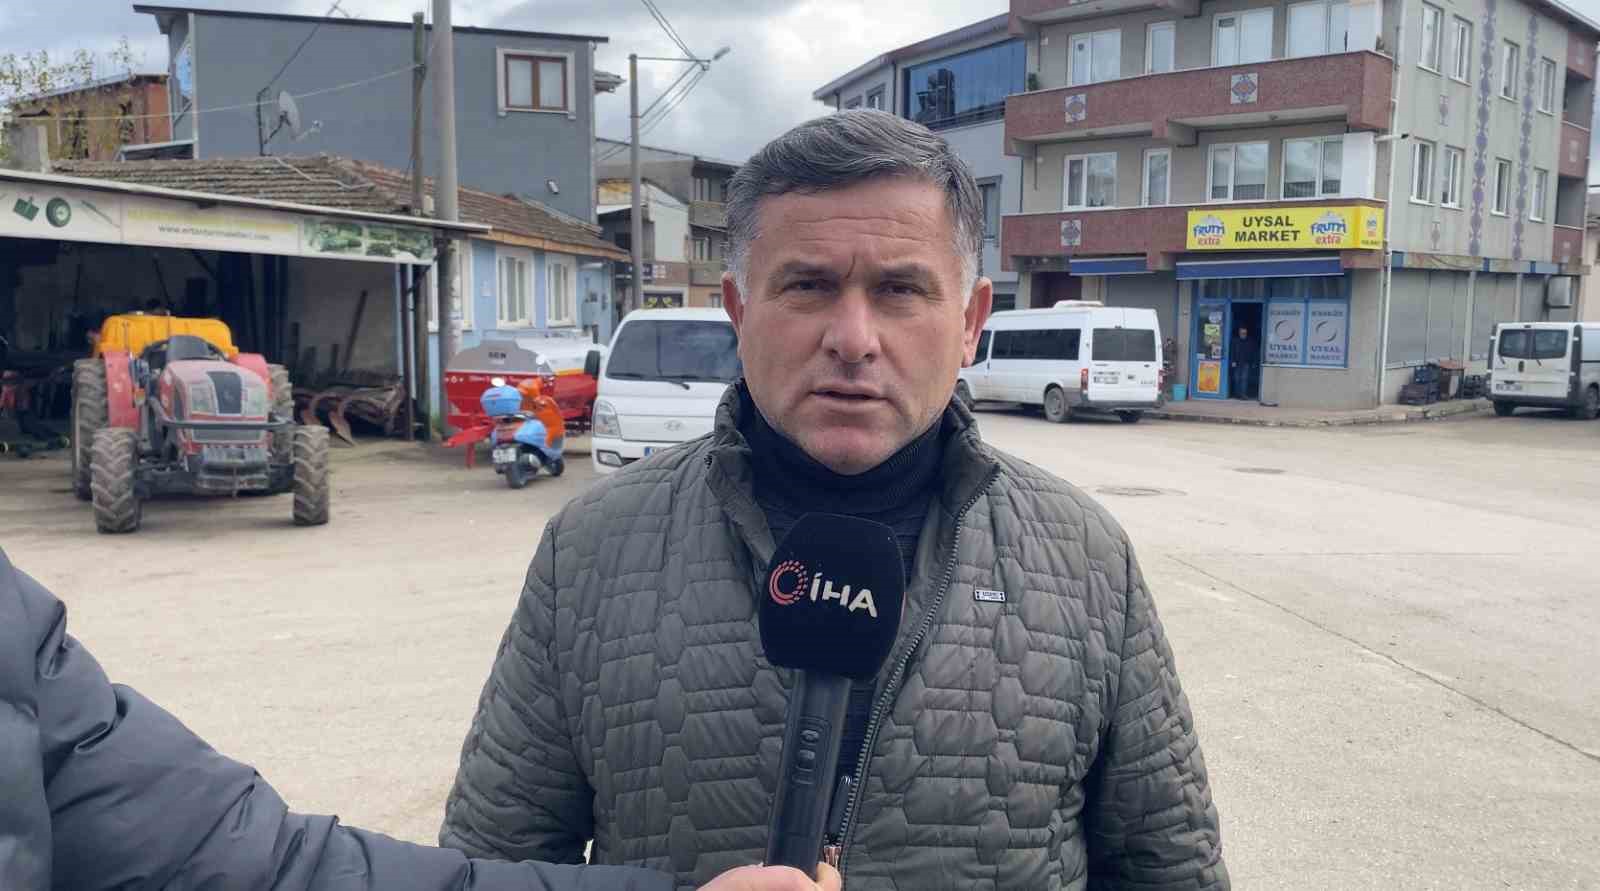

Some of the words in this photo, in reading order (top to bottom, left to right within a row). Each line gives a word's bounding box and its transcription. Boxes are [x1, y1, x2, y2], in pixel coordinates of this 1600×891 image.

[1242, 215, 1294, 228] UYSAL
[1198, 236, 1221, 246] extra
[1234, 230, 1301, 242] MARKET
[1315, 234, 1343, 245] extra
[810, 571, 878, 618] İHA
